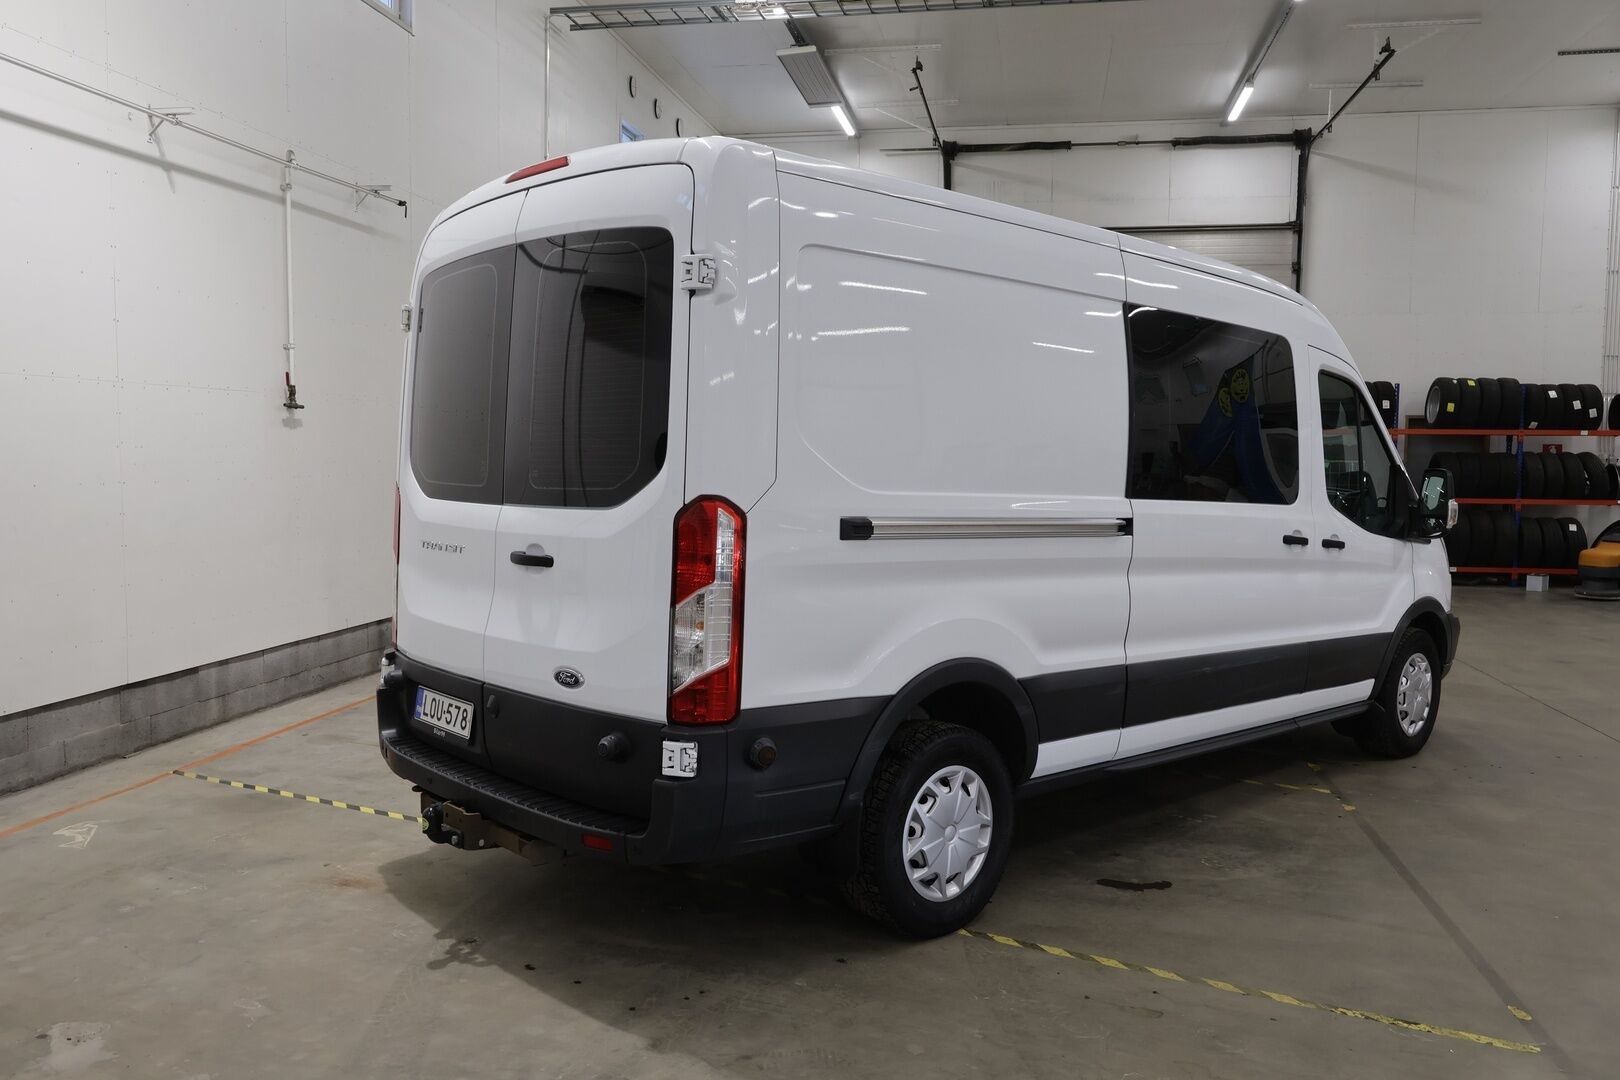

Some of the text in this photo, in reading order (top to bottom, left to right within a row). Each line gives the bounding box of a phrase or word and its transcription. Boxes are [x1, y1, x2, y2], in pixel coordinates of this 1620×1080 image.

[421, 540, 466, 554] TRANSIT
[558, 671, 576, 684] Ford
[422, 694, 468, 731] LOU-578
